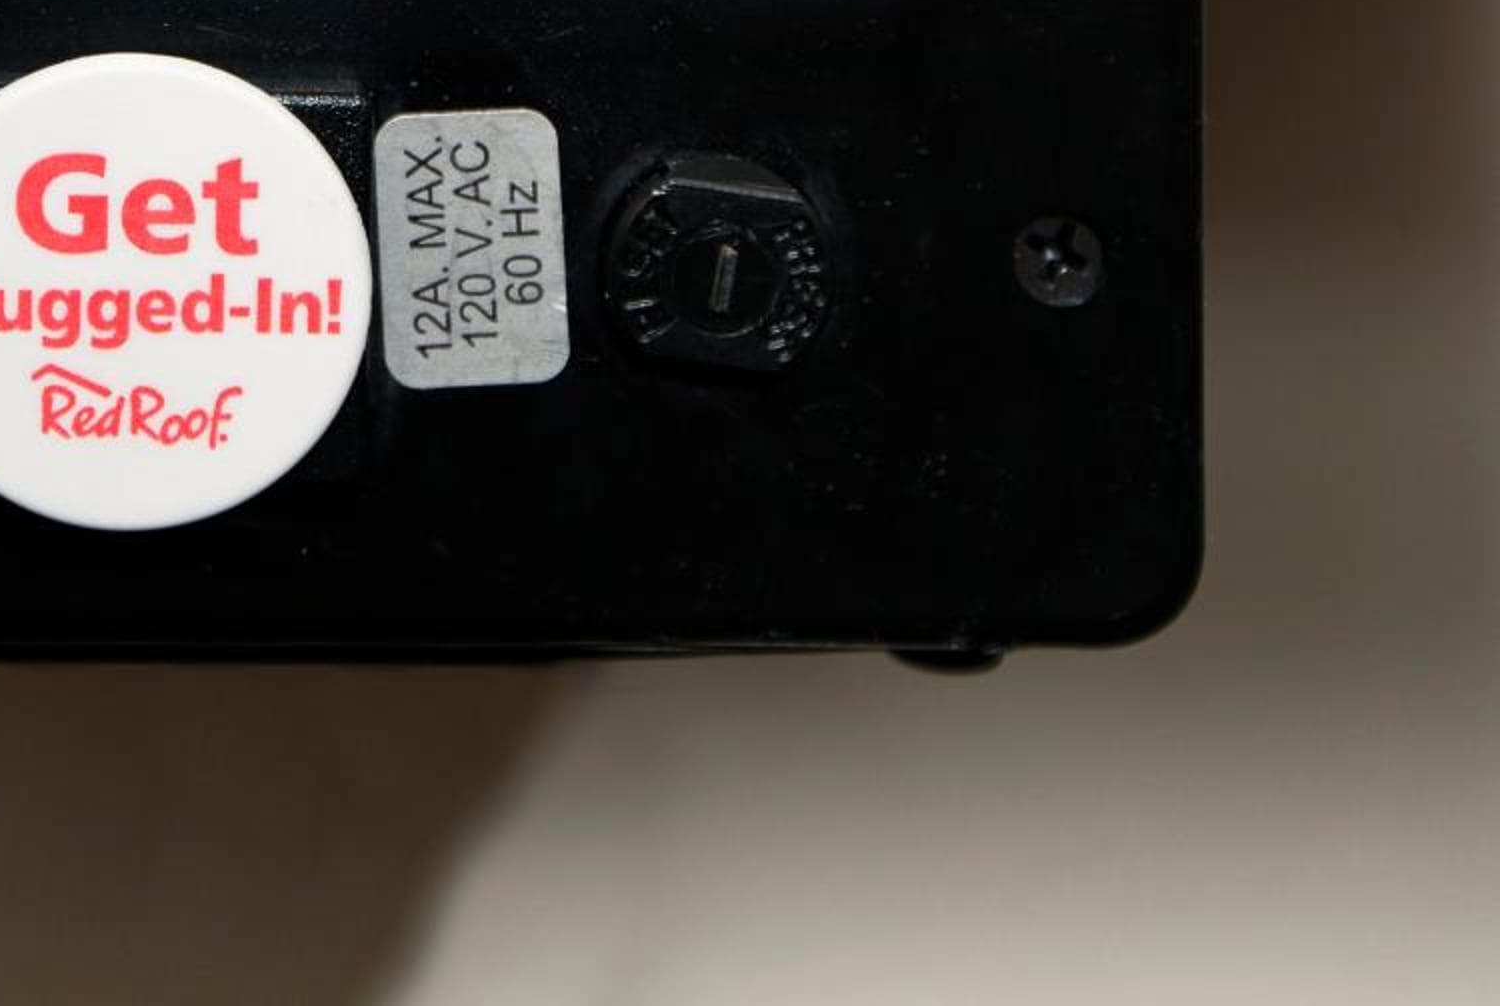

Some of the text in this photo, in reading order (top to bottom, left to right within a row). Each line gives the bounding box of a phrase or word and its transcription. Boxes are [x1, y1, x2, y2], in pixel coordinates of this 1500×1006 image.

[15, 152, 260, 256] Get
[404, 136, 452, 358] 12A. MAX.
[500, 181, 543, 305] 60 Hz
[457, 274, 498, 348] 120
